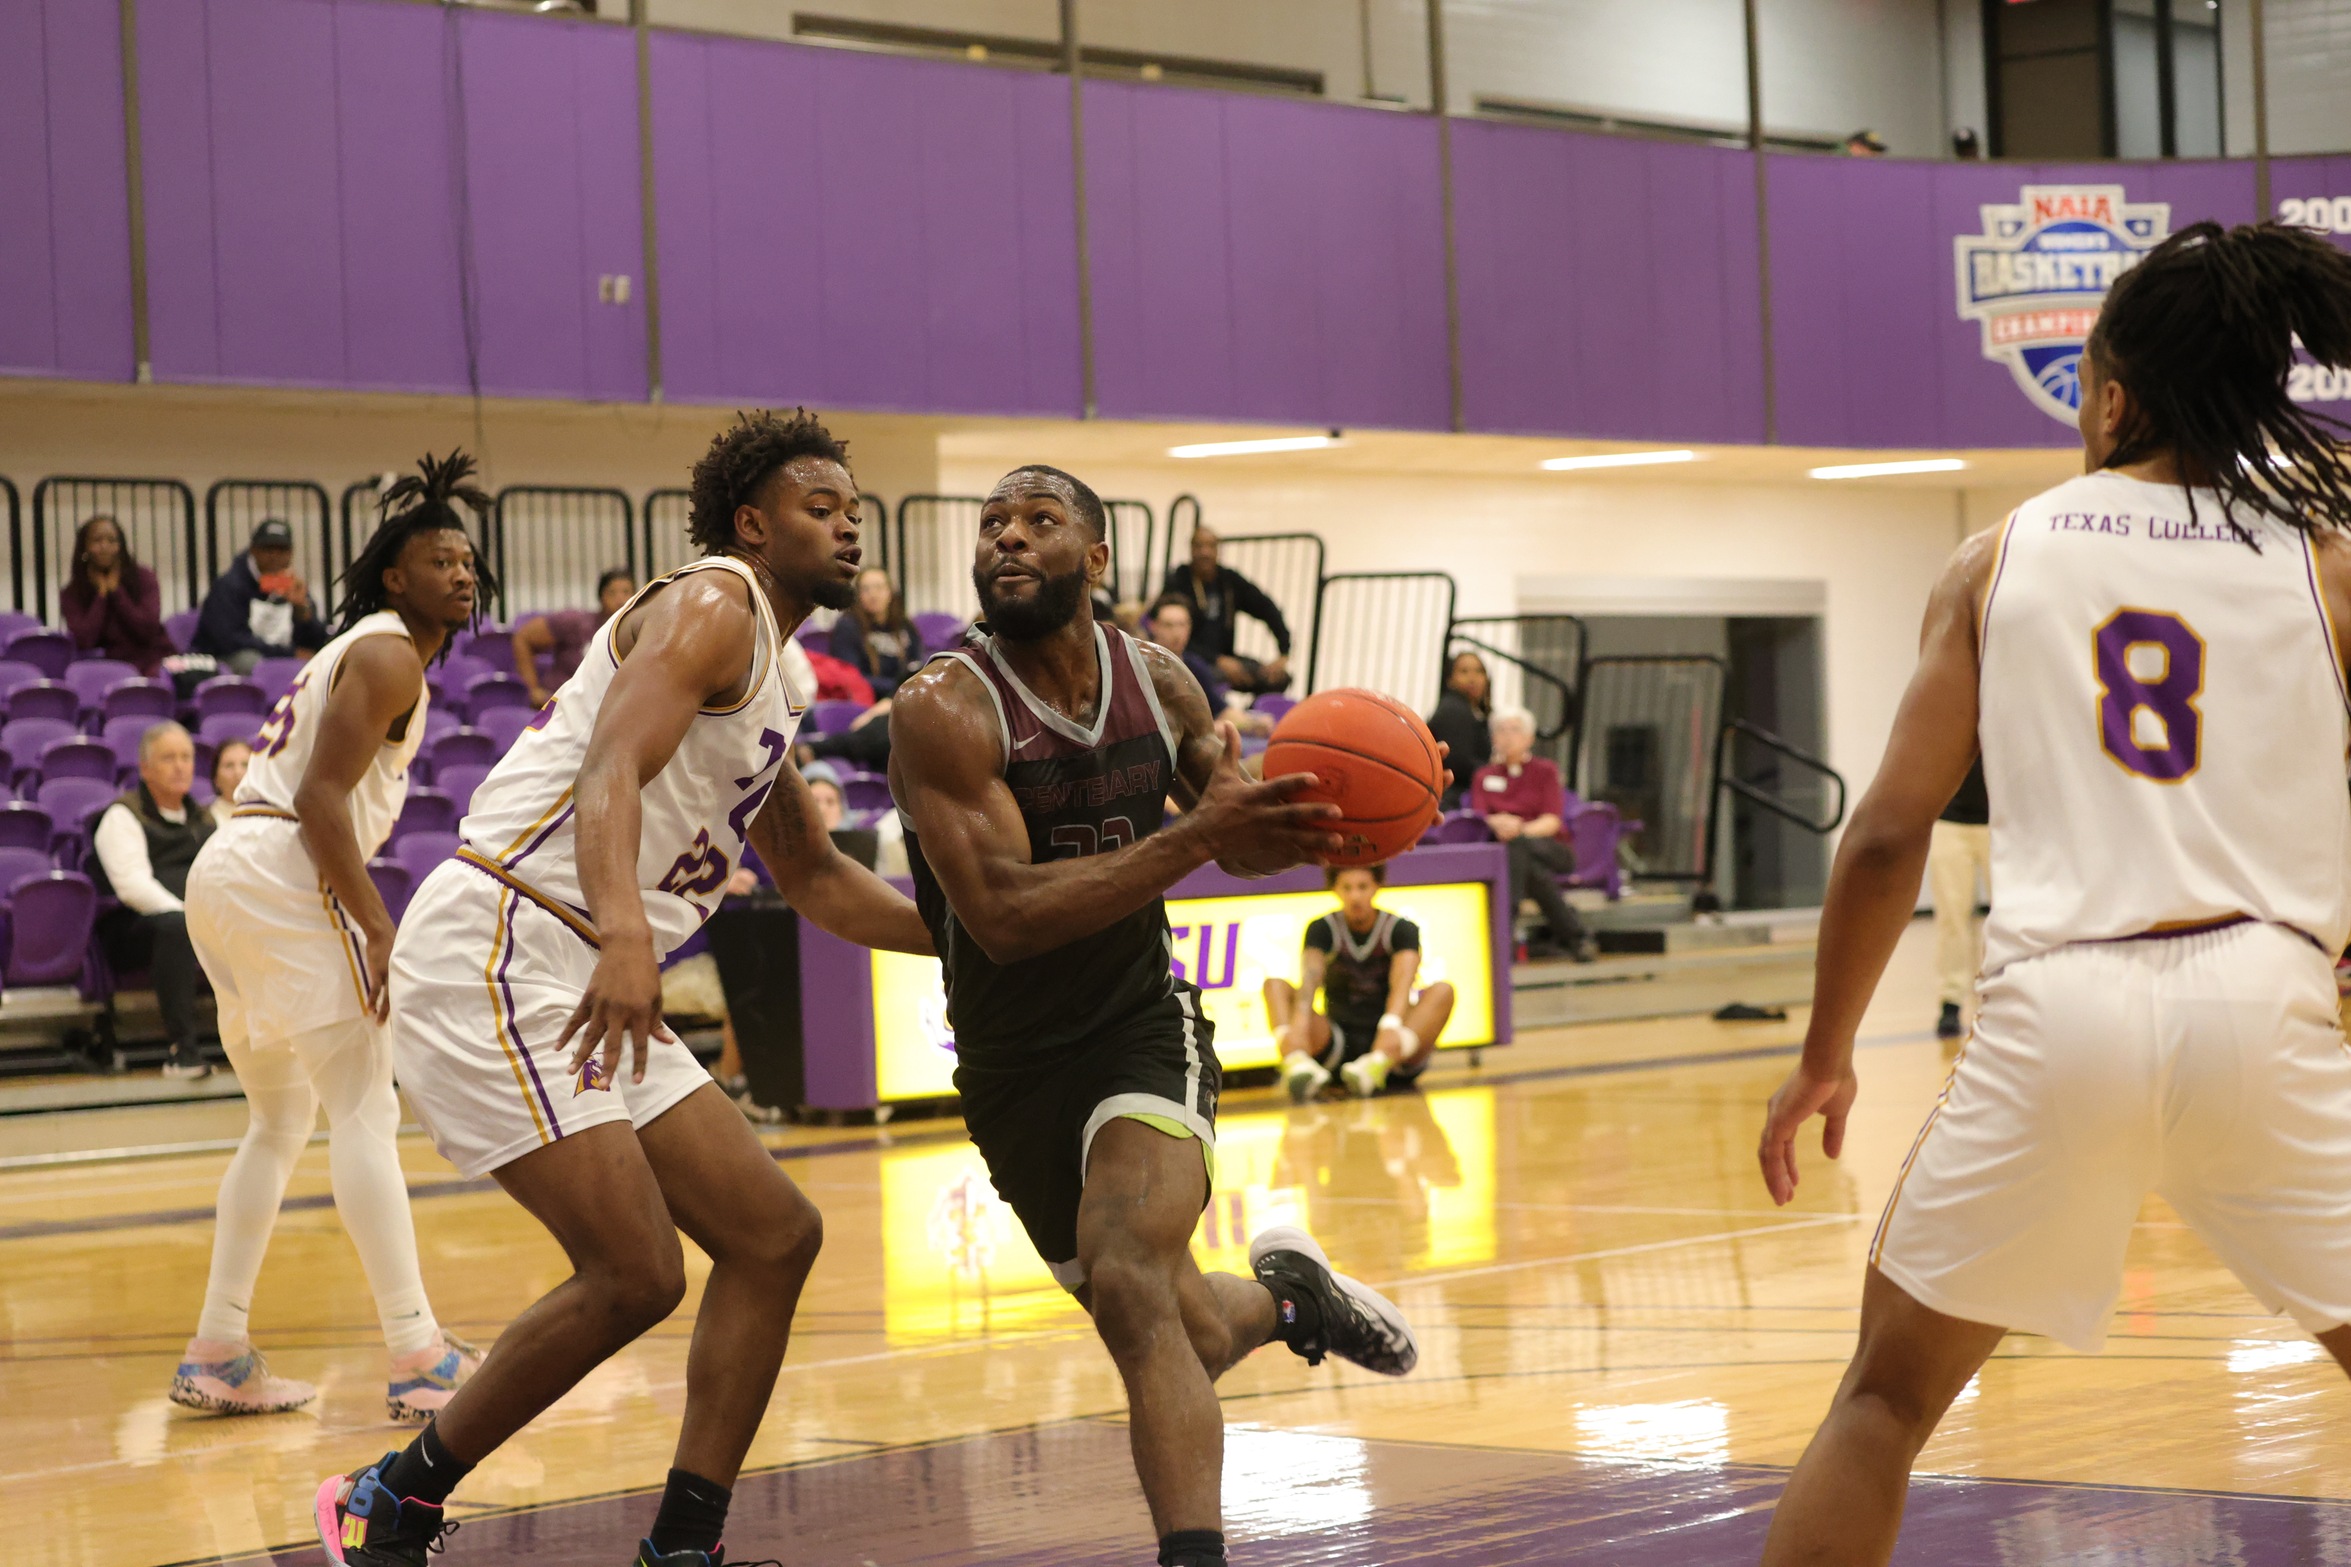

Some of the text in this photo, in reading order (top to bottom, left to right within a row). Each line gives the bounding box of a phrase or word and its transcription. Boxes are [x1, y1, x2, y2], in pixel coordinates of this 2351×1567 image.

[2034, 195, 2114, 225] NAIA
[1974, 251, 2150, 297] BASKETB
[1996, 312, 2096, 339] CHAMPI
[2049, 513, 2131, 537] TEXAS
[2091, 605, 2206, 785] 8
[1014, 759, 1161, 814] CENTEARY
